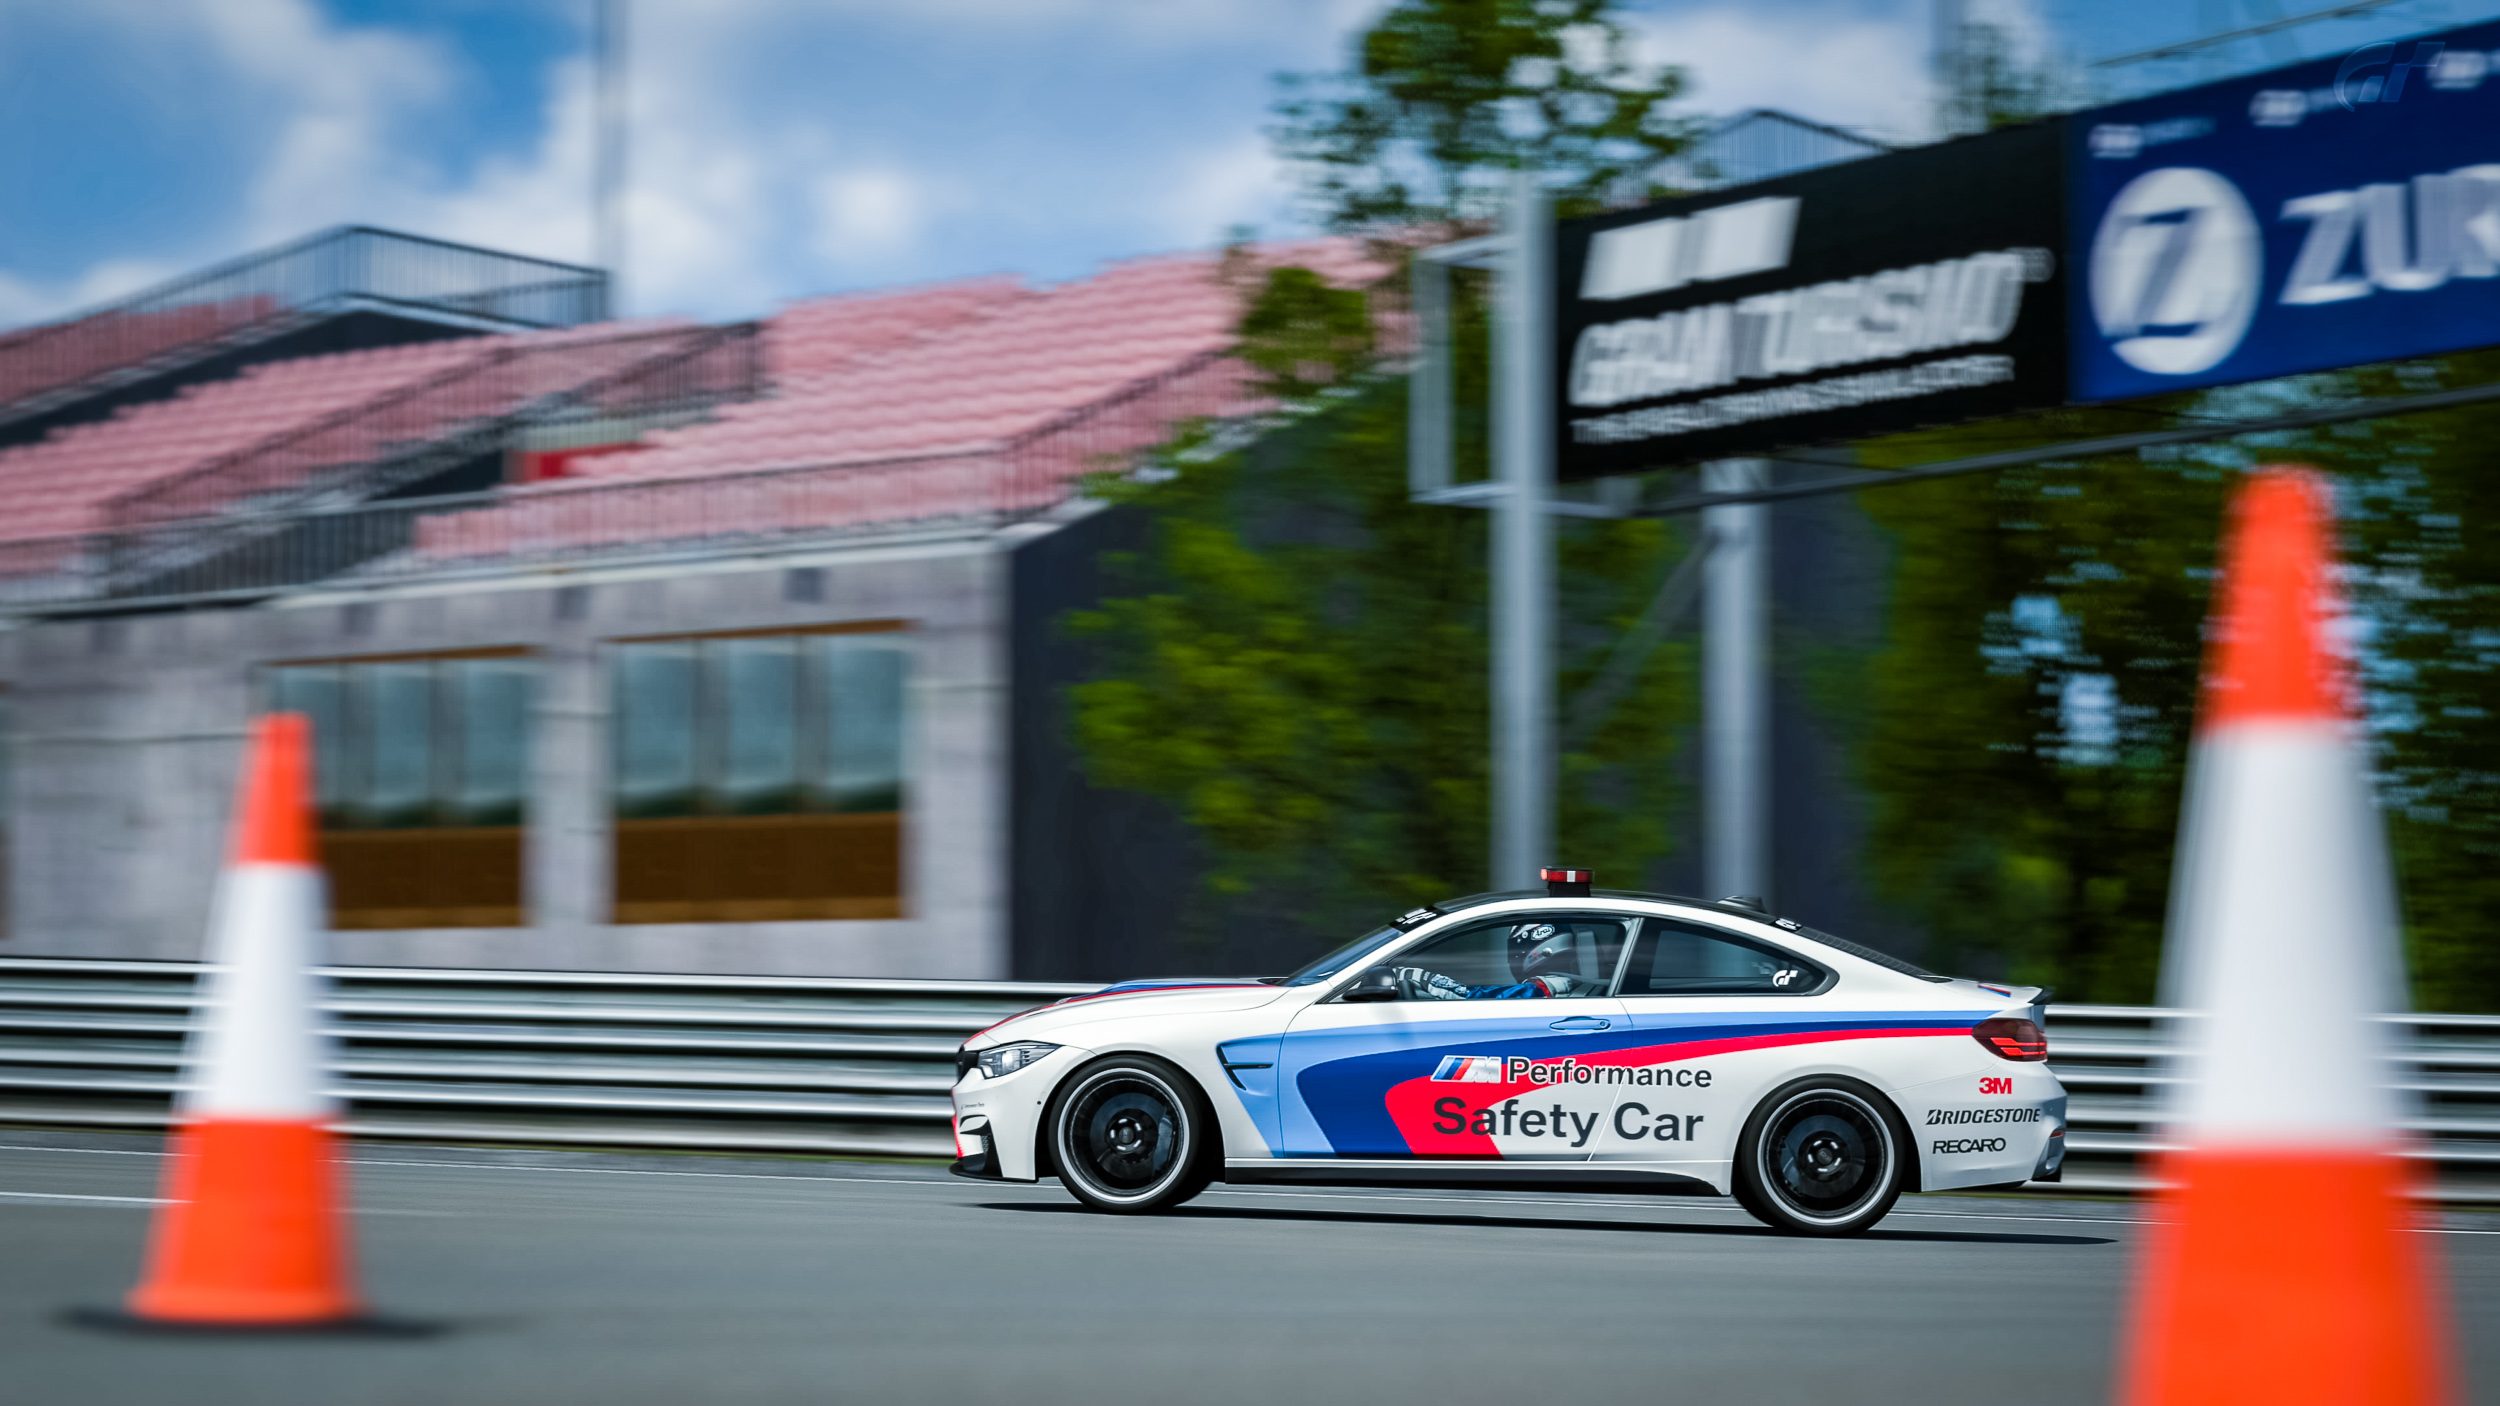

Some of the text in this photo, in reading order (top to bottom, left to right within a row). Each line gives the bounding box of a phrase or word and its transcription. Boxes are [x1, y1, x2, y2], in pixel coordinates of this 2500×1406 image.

[1508, 1058, 1713, 1088] Performance
[1979, 1077, 2012, 1094] 3M
[1433, 1097, 1703, 1147] Safety Car
[1925, 1108, 2041, 1125] BRIDGESTONE
[1932, 1138, 2006, 1154] RECARO
